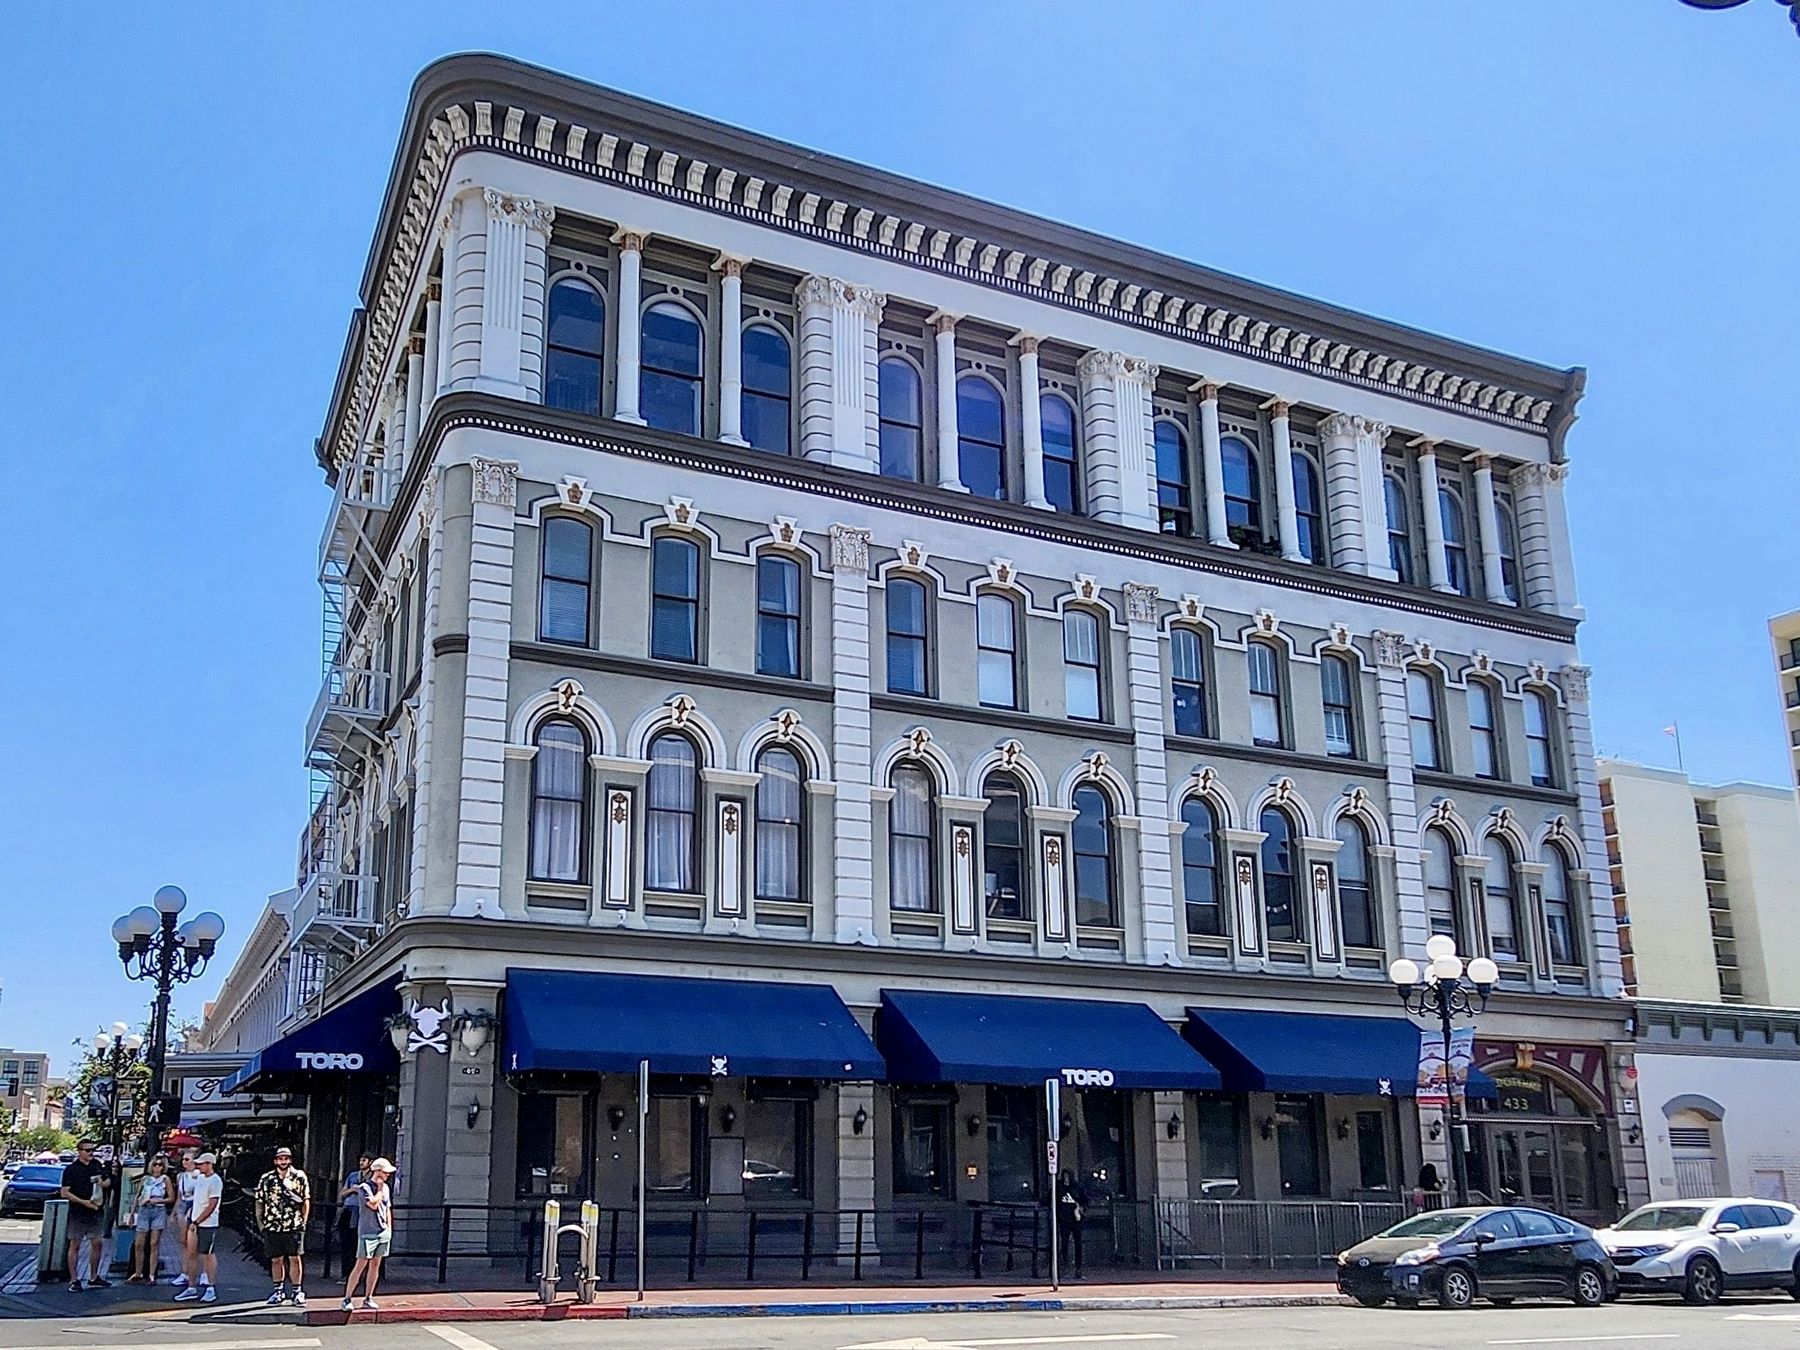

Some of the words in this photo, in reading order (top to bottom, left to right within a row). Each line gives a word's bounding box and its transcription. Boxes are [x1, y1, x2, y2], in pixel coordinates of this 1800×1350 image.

[296, 1052, 363, 1070] TORO
[1061, 1068, 1114, 1087] TORO
[1504, 1097, 1529, 1110] 433
